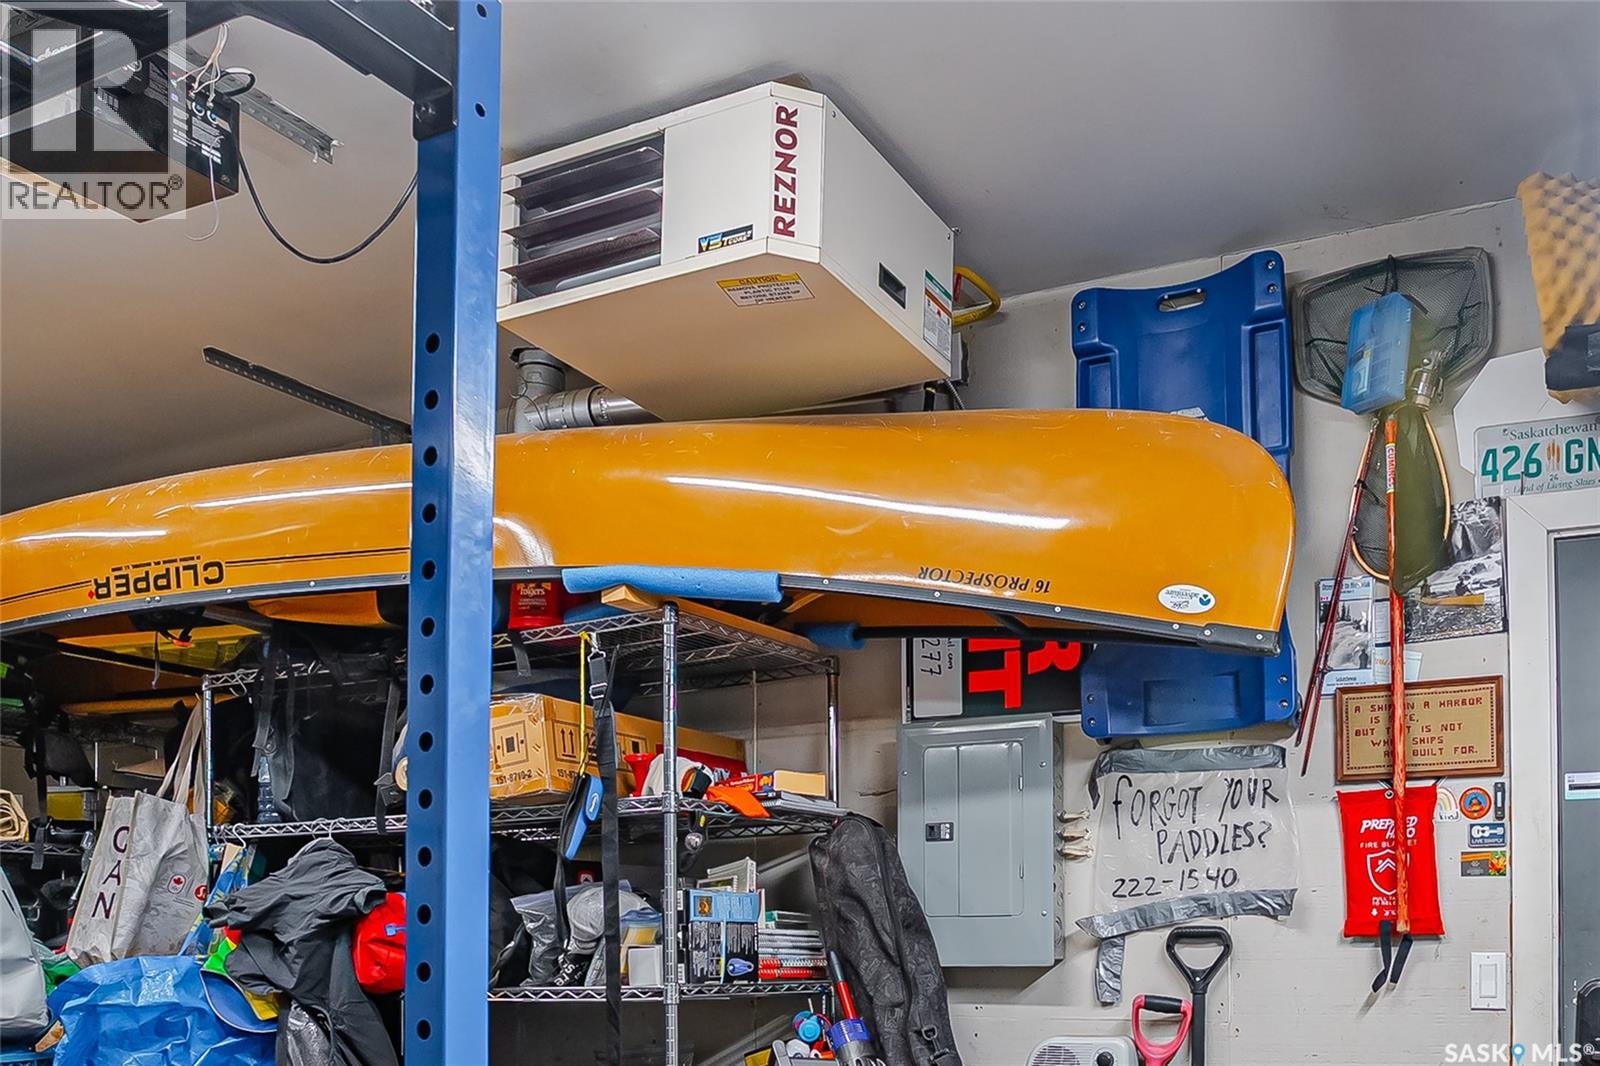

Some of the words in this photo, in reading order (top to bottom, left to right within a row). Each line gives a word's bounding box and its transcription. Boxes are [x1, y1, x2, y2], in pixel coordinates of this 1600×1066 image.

[773, 105, 798, 237] REZNOR
[1509, 422, 1597, 441] Saskatchewan
[1481, 442, 1542, 483] 426
[93, 561, 225, 600] CLIPPER
[918, 566, 1030, 592] PROSPECTOR
[1423, 700, 1430, 709] A
[1439, 697, 1483, 708] HARBOR
[1354, 728, 1375, 737] BUT
[1421, 725, 1432, 734] IS
[1441, 722, 1464, 732] NOT
[1370, 716, 1380, 725] IS
[1412, 736, 1444, 746] SHIPS
[1412, 748, 1444, 757] BUILT
[1218, 778, 1280, 822] YOUR
[1157, 821, 1273, 865] PADDLES?
[1112, 868, 1240, 898] 222-1540
